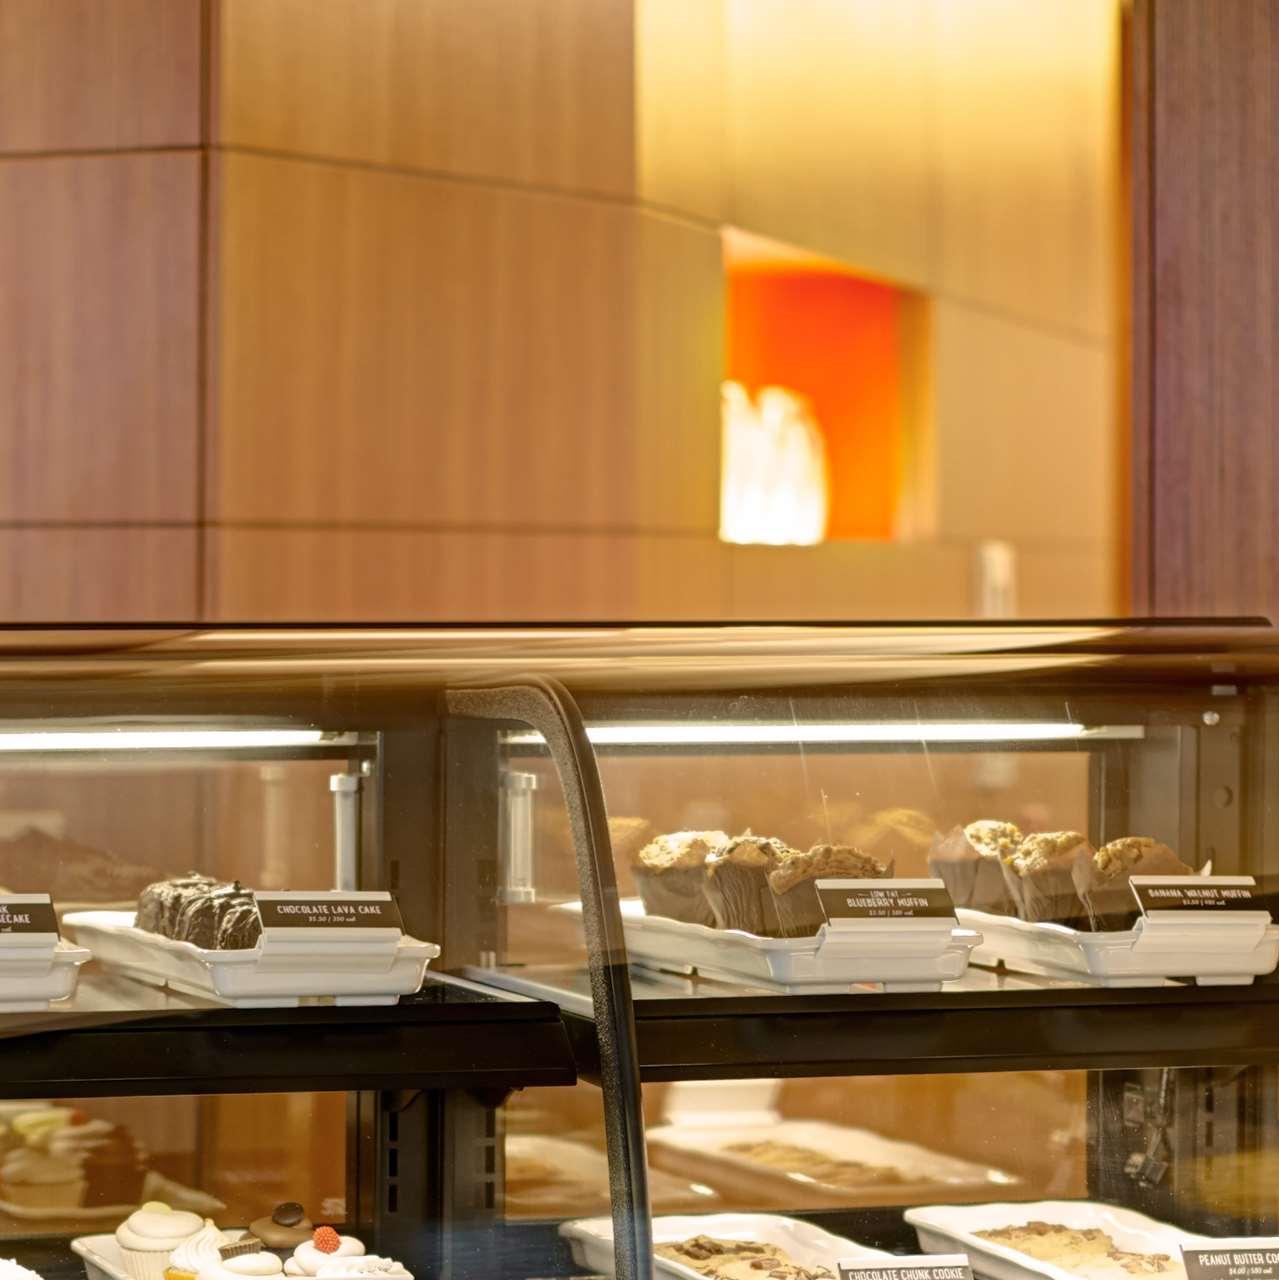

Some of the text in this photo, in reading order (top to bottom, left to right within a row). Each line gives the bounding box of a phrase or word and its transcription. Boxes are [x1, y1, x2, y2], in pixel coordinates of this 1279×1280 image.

[1148, 889, 1251, 898] BANANA WALNUT MUFFIN
[847, 898, 929, 907] BLUEBERRY MUFFIN
[277, 905, 381, 914] CHOCOLATE LAVA CAKE
[1198, 1254, 1231, 1266] PEANUT
[1233, 1254, 1264, 1265] BUTTER
[900, 1269, 931, 1280] CHUNK
[933, 1268, 964, 1280] COOKIE
